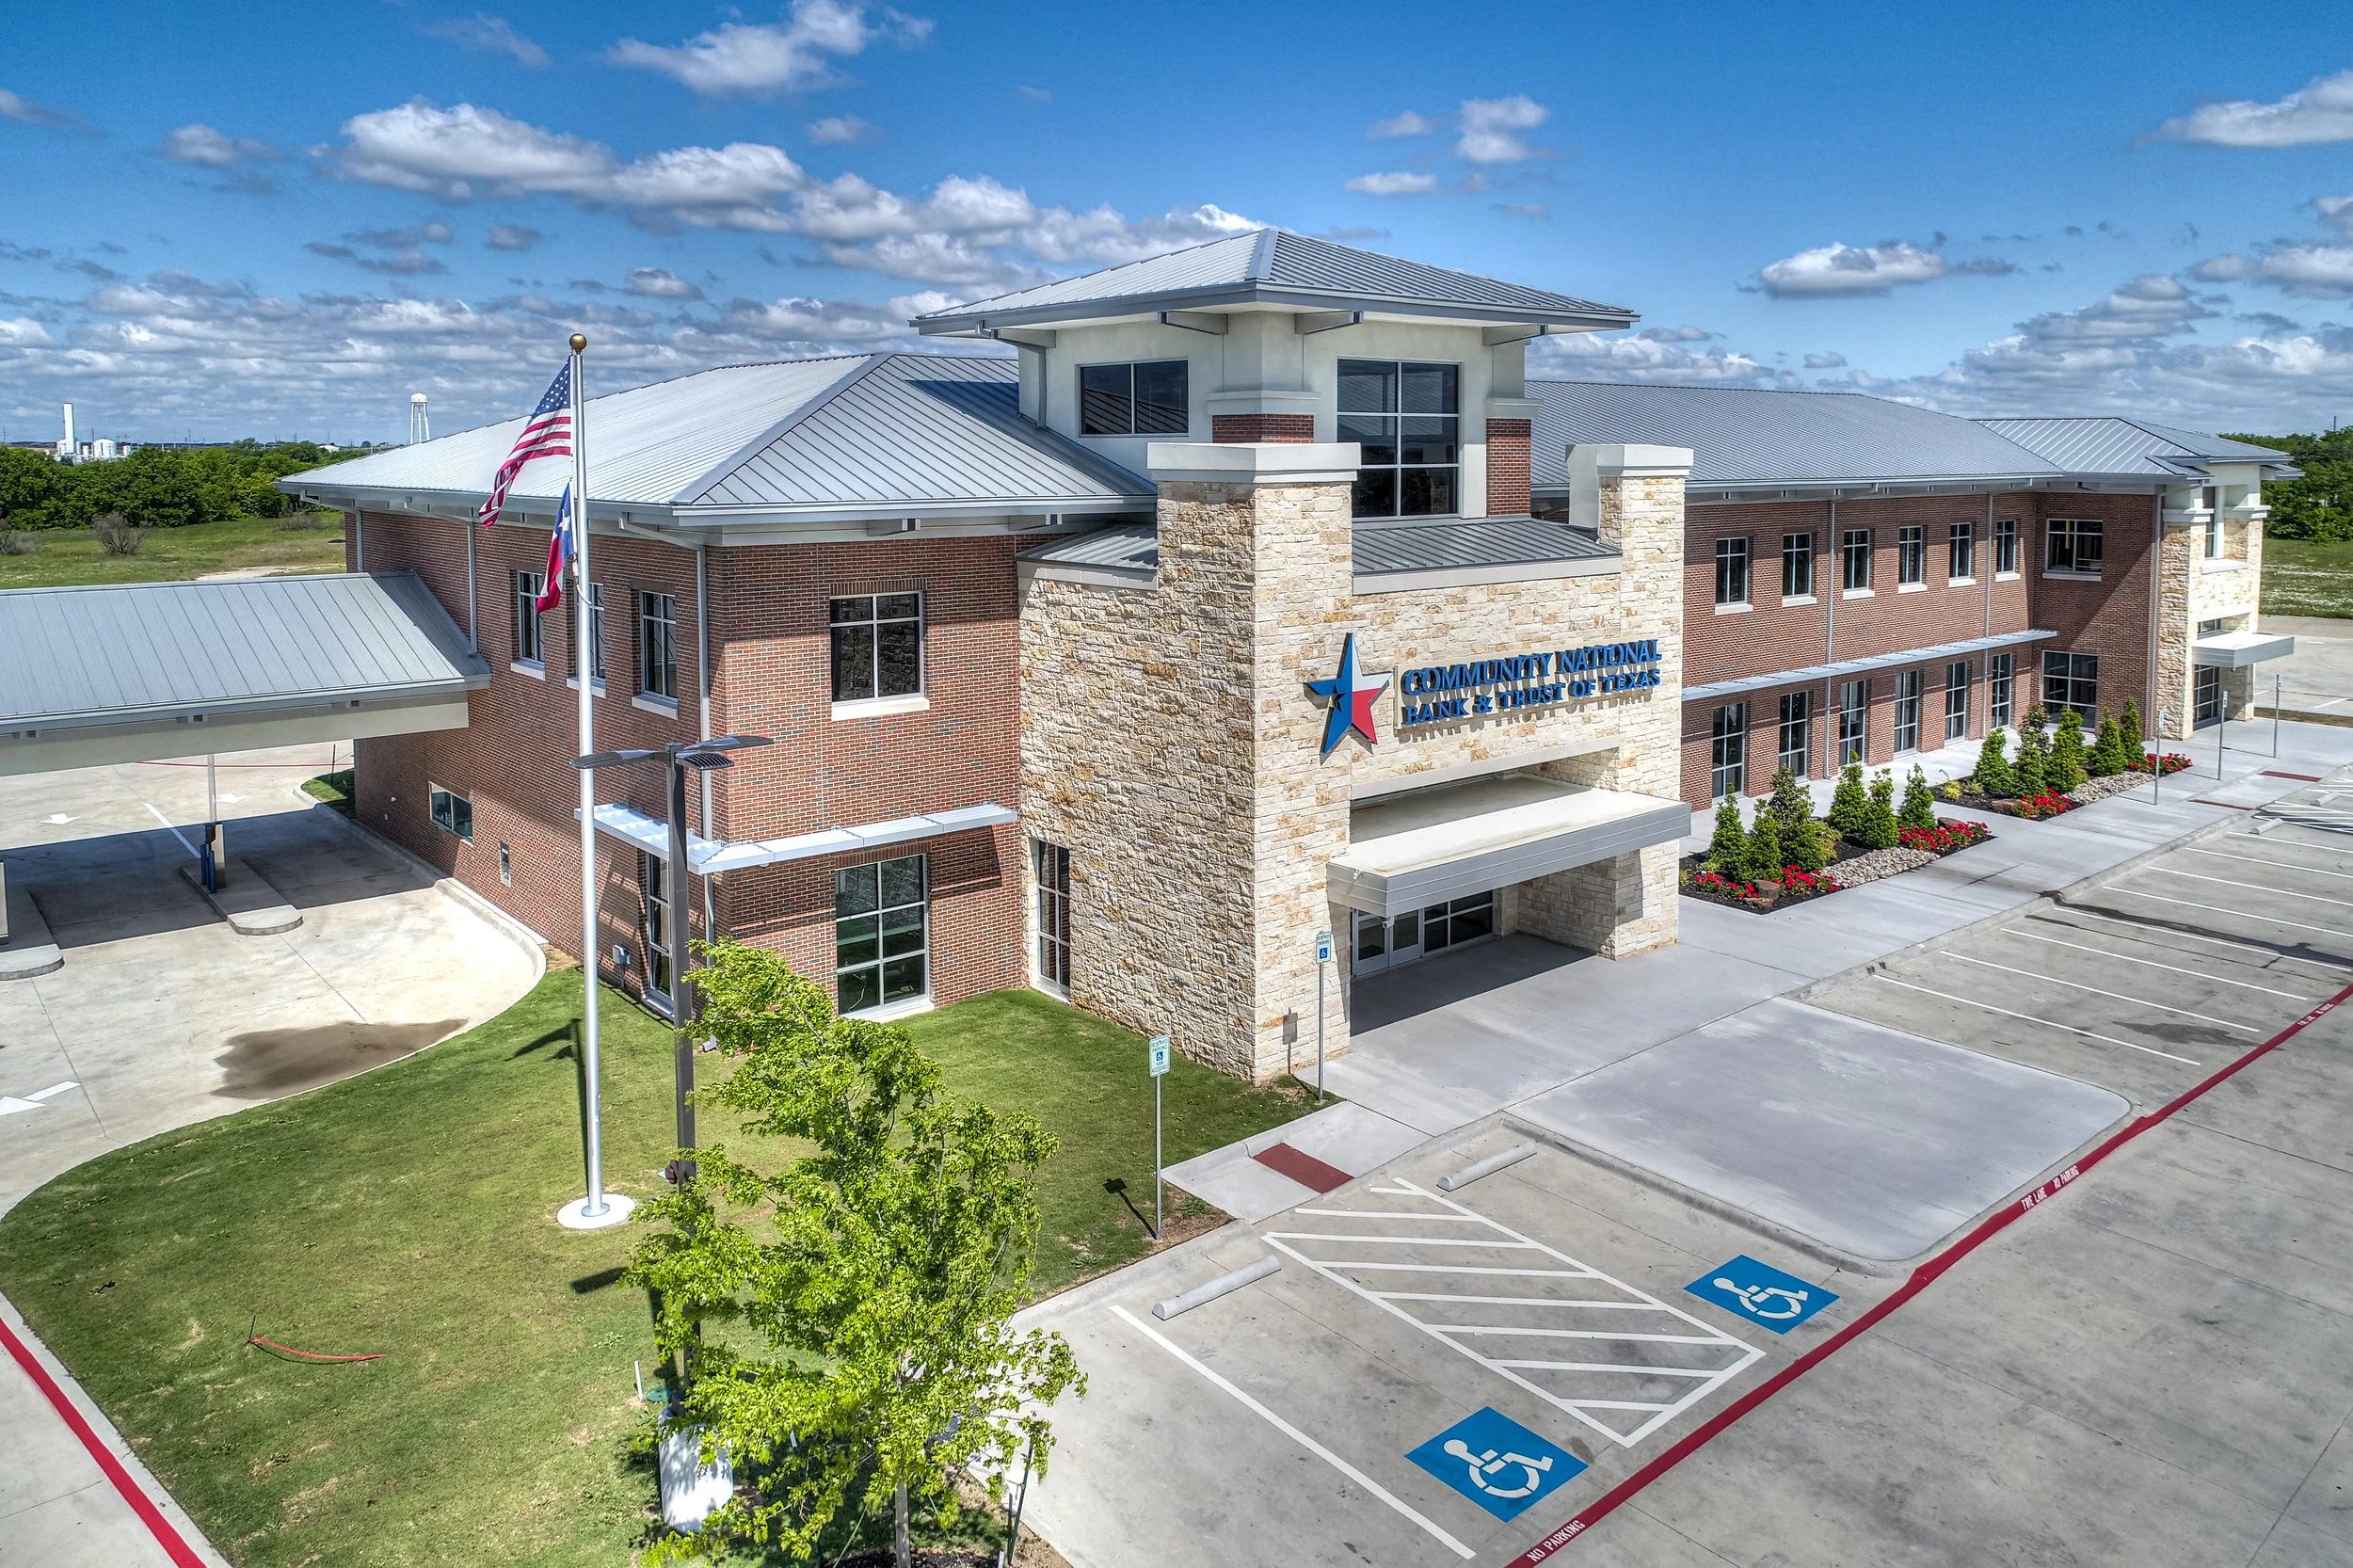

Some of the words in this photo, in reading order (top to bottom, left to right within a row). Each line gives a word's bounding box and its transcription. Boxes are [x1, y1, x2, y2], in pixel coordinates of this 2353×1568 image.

[1401, 652, 1553, 696] COMMUNITY
[1555, 639, 1662, 674] NATIONAL
[1402, 697, 1469, 725] BANK
[1474, 695, 1493, 713] &
[1497, 682, 1565, 708] TRUST
[1568, 679, 1596, 697] OF
[1600, 669, 1661, 693] TEXAS
[2022, 1195, 2034, 1210] FIRE
[2033, 1187, 2047, 1203] LANE
[2053, 1177, 2060, 1190] NO
[2059, 1164, 2079, 1185] PARKING
[1527, 1548, 1546, 1562] NO
[1543, 1520, 1586, 1551] PARKING
